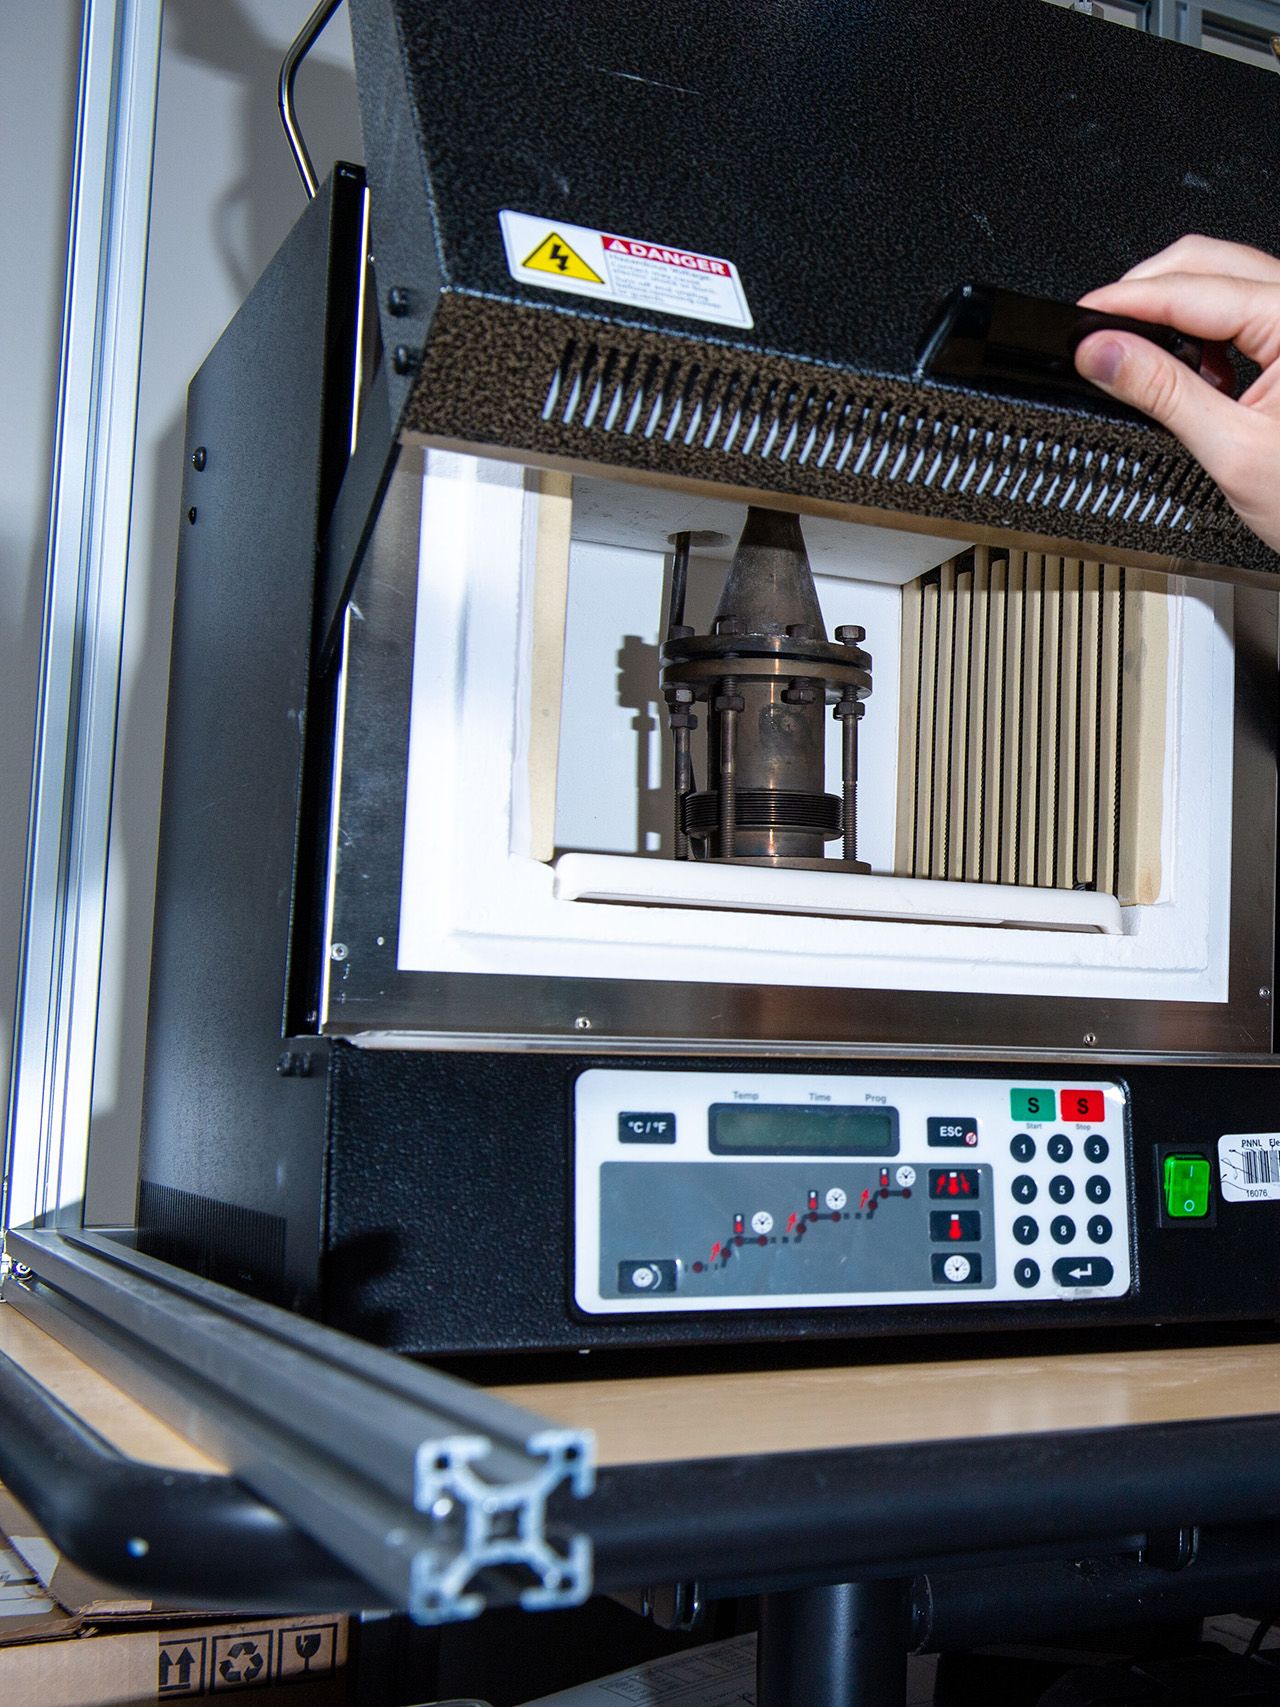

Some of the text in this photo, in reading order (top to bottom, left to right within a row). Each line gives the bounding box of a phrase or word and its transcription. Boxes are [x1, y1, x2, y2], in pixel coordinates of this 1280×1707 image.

[630, 243, 725, 275] DANGER
[733, 1091, 759, 1101] Temp
[809, 1092, 831, 1101] Time
[865, 1093, 886, 1104] Prog
[1028, 1097, 1039, 1114] S
[1077, 1098, 1089, 1115] S
[940, 1126, 963, 1137] ESC
[1076, 1123, 1091, 1131] Stop
[1241, 1139, 1262, 1147] PNNL
[1020, 1144, 1026, 1154] 1
[1057, 1144, 1064, 1154] 2
[1094, 1144, 1100, 1155] 3
[1021, 1185, 1028, 1196] 4
[1059, 1185, 1066, 1196] 5
[1095, 1185, 1102, 1196] 6
[1023, 1225, 1030, 1236] 7
[1060, 1225, 1067, 1236] 8
[1097, 1225, 1103, 1235] 9
[1024, 1267, 1031, 1278] 0
